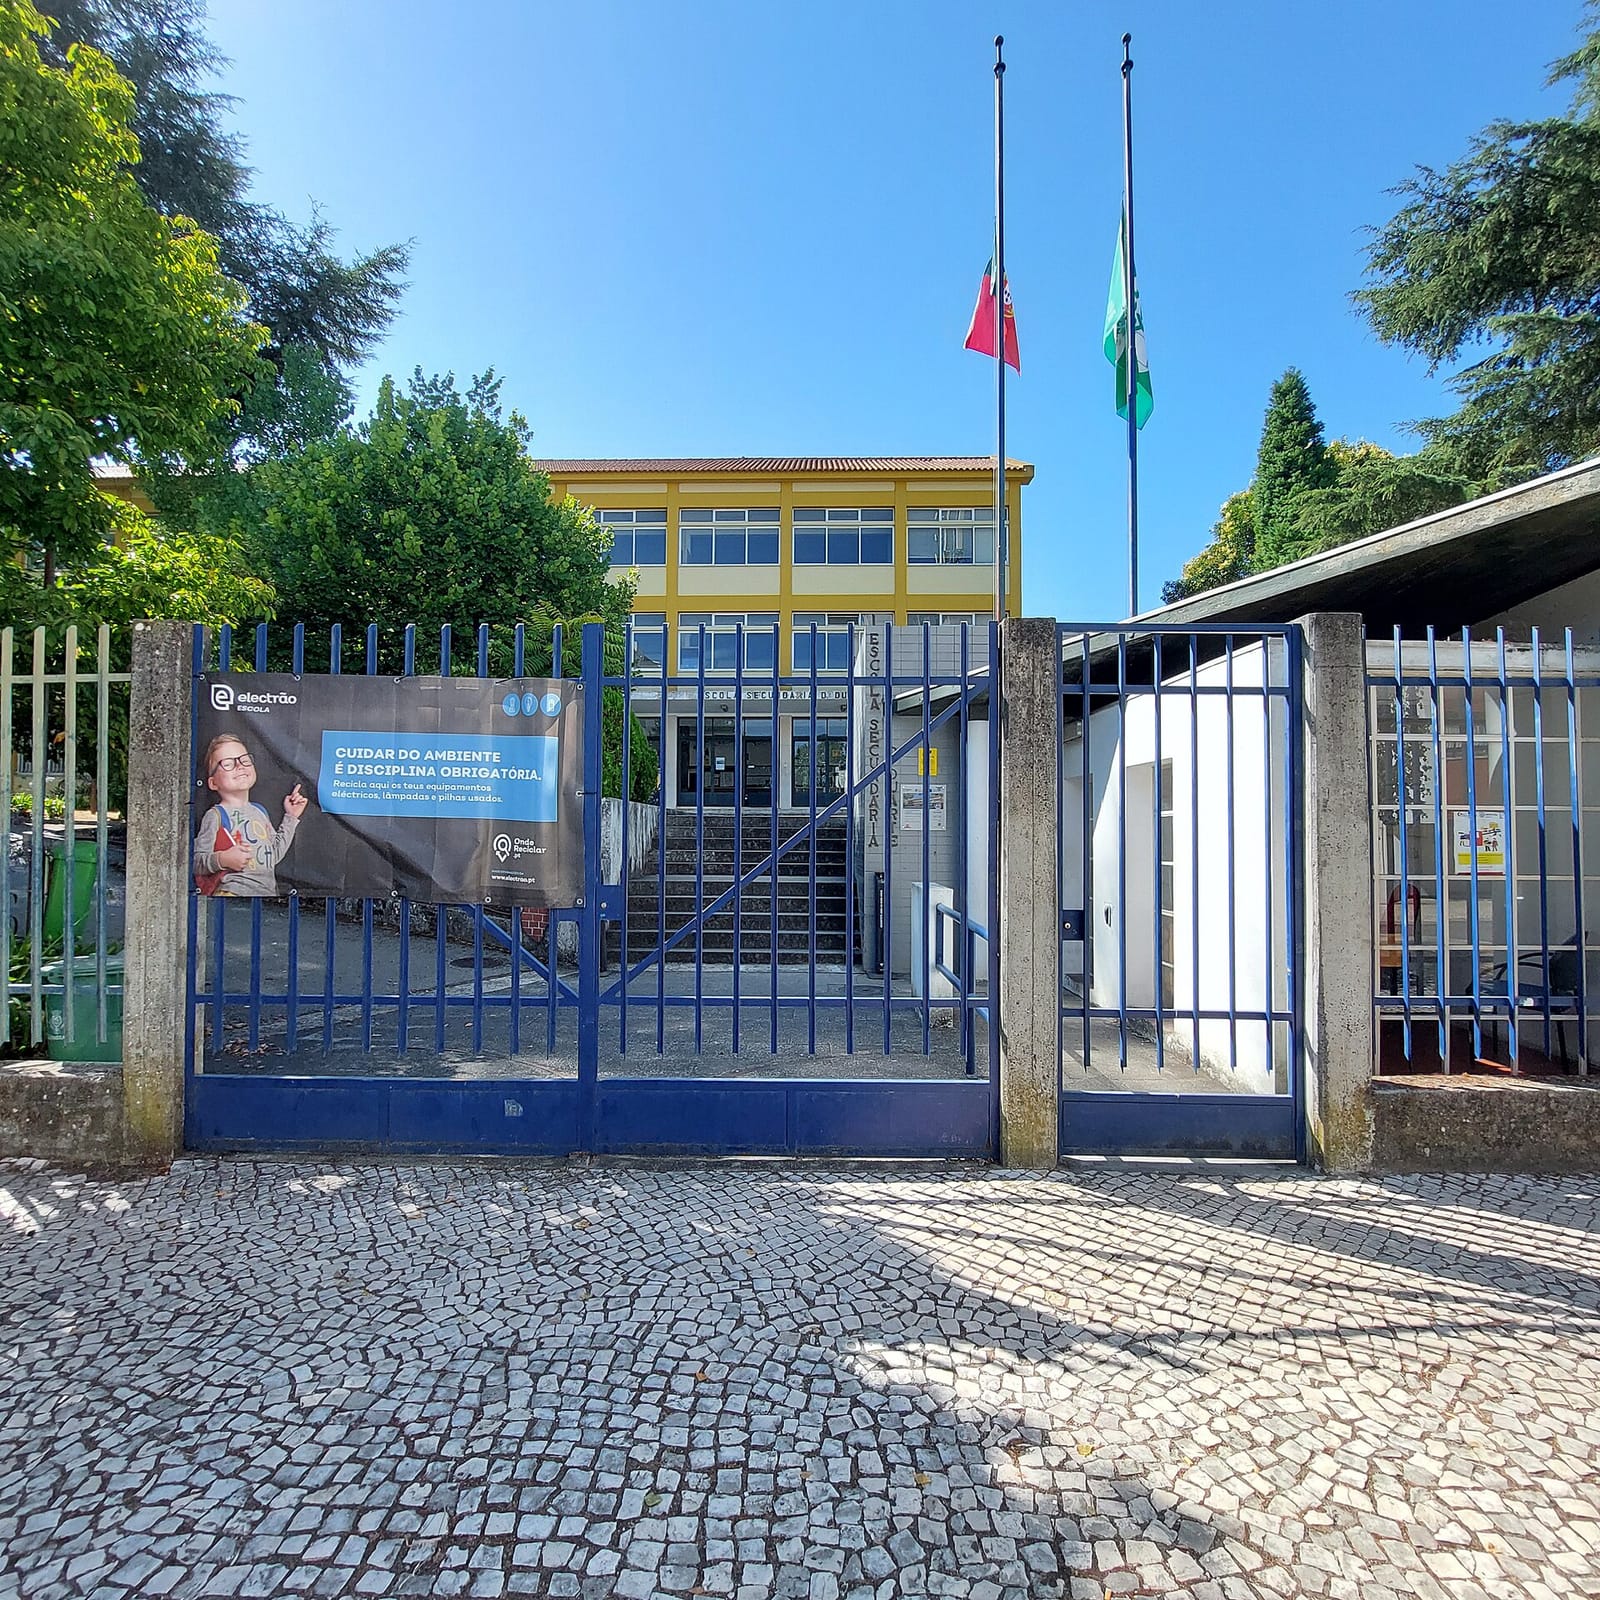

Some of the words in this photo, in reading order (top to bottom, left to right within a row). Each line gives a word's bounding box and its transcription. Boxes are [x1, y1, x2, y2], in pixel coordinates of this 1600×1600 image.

[868, 632, 880, 710] ESCLA
[237, 692, 297, 704] electrão
[701, 691, 738, 699] SCOL
[236, 704, 270, 713] ESCOLA
[335, 747, 395, 760] CUIDAR
[398, 749, 420, 760] DO
[424, 750, 501, 763] AMBIENTE
[334, 761, 344, 775] É
[347, 764, 436, 777] DISCIPLINA
[440, 765, 542, 781] OBRIGATÓRIA.
[333, 780, 367, 788] Recicla
[369, 781, 390, 790] aqui
[403, 781, 424, 790] teus
[426, 783, 492, 793] equipamentos
[867, 719, 880, 848] SECUDÁRIA
[382, 791, 430, 801] lâmpadas
[438, 792, 466, 803] pilhas
[514, 838, 535, 846] Onde
[513, 845, 547, 854] Reciclar
